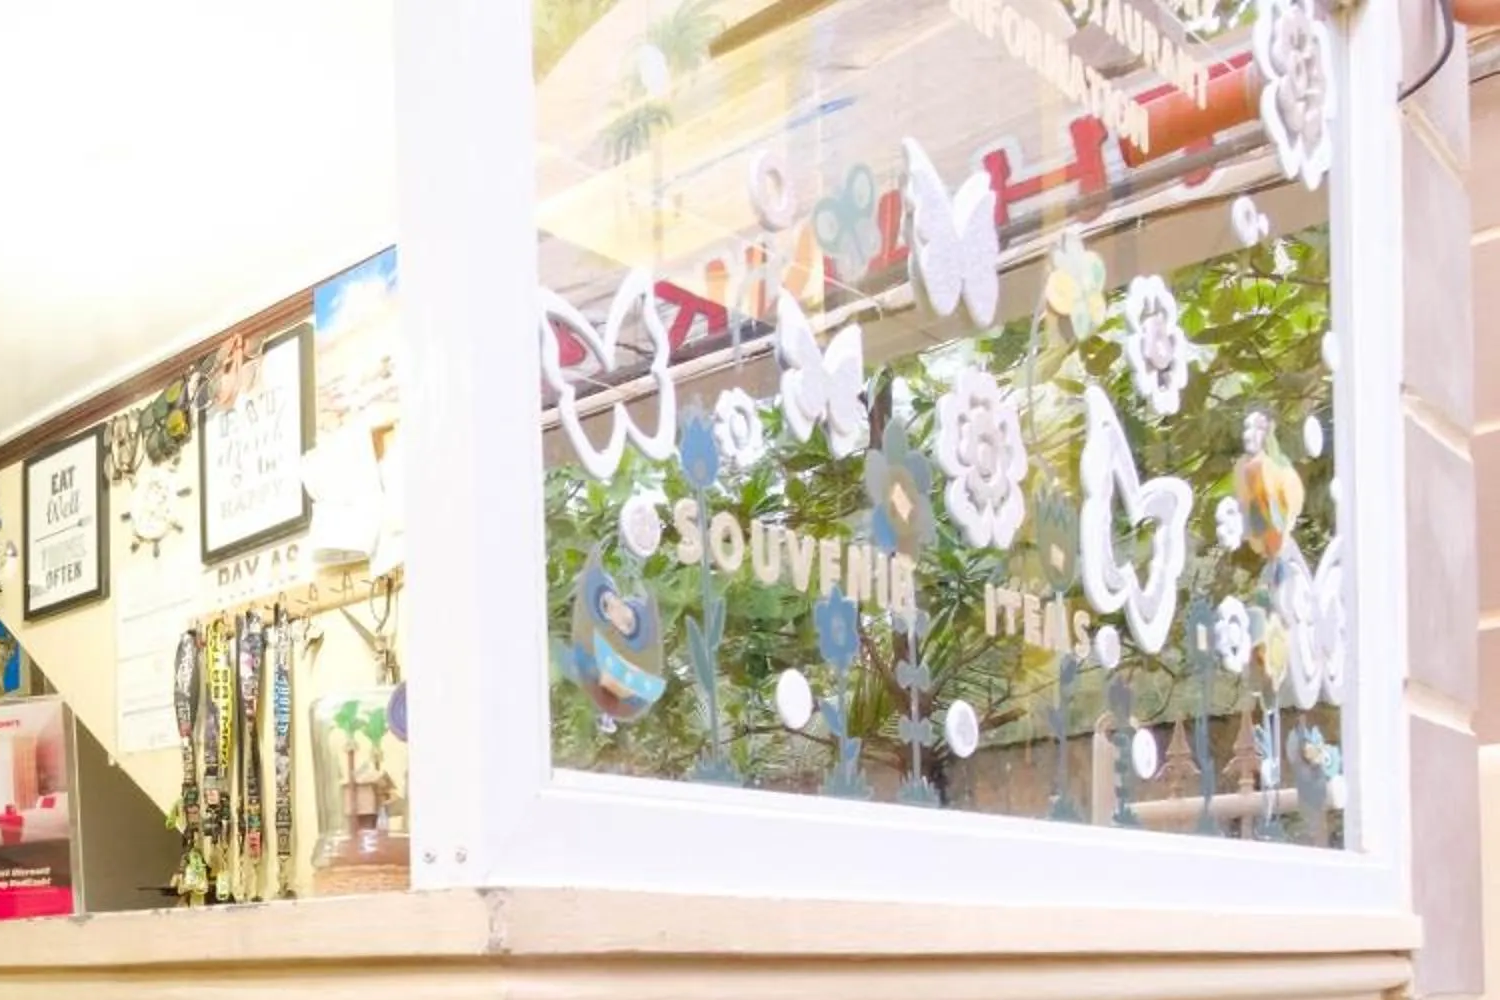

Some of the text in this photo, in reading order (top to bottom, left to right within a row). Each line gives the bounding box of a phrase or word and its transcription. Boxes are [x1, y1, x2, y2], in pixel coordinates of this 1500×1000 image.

[950, 0, 1150, 155] NFORMATION
[51, 465, 76, 496] EAT
[46, 560, 82, 589] OFTEN
[672, 496, 1092, 660] SOUVENIR ITEMS
